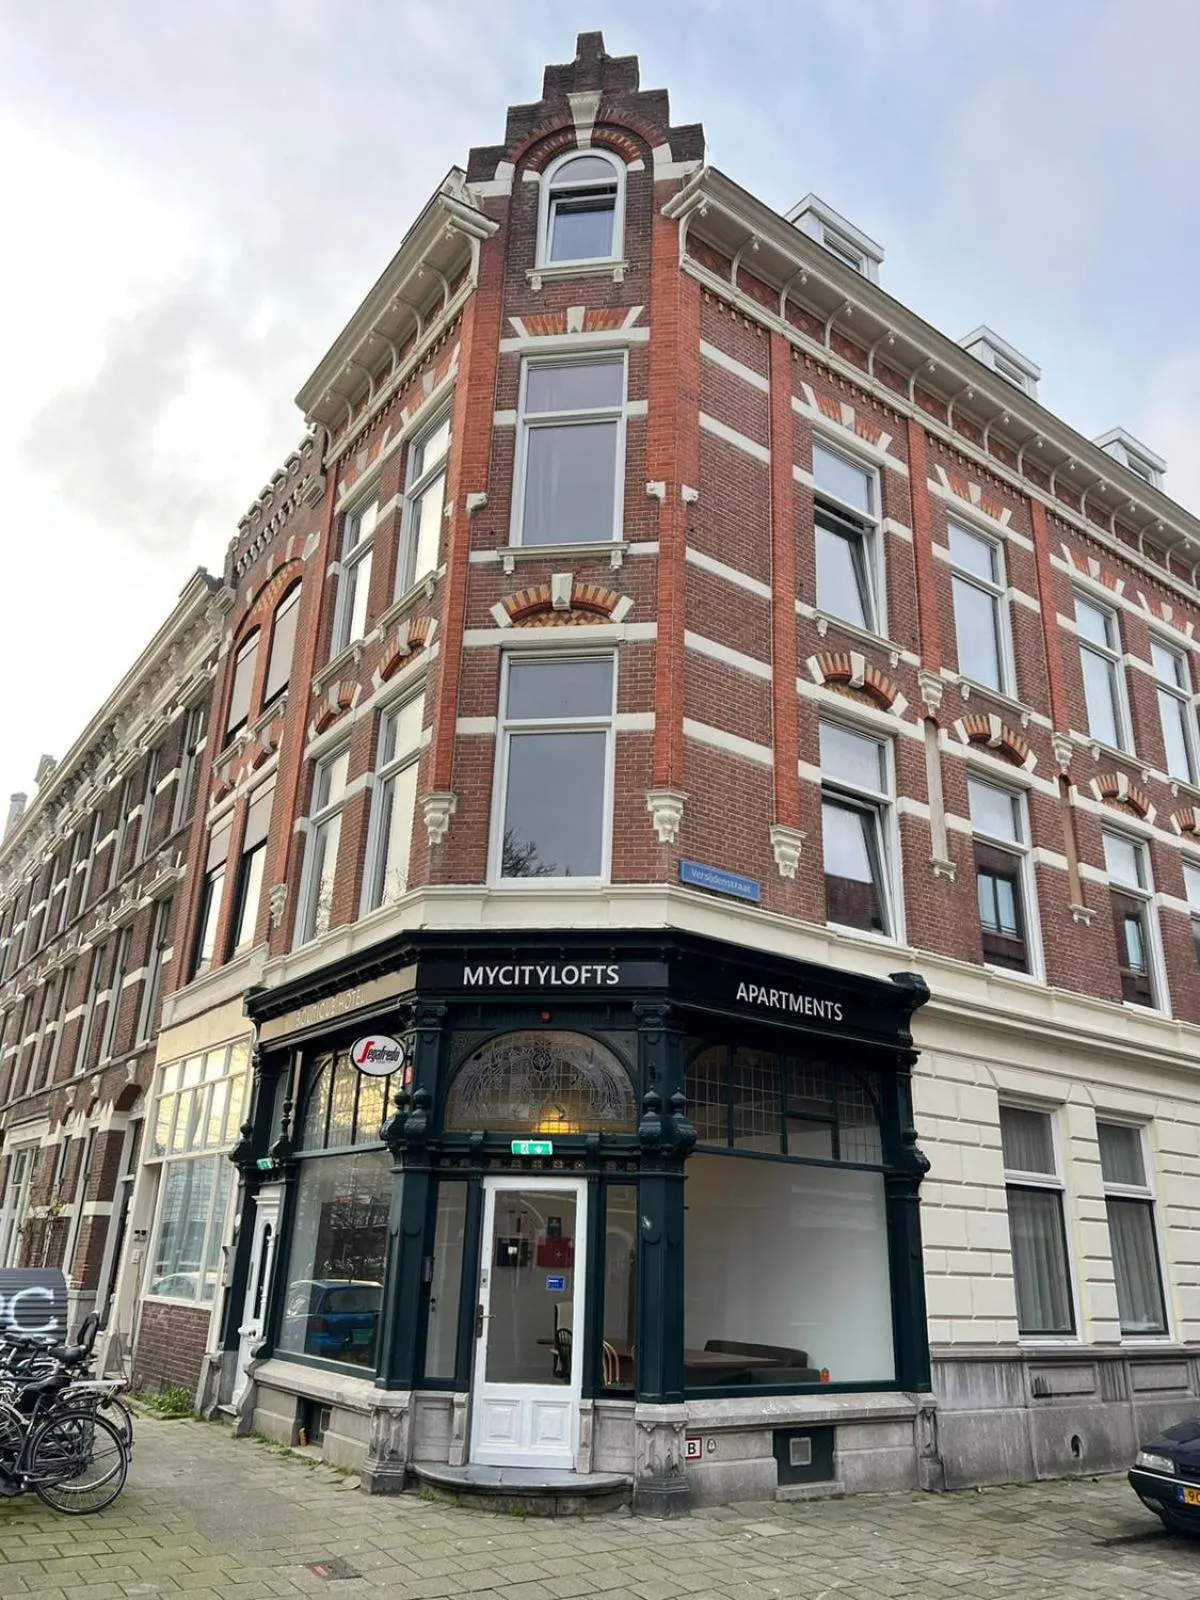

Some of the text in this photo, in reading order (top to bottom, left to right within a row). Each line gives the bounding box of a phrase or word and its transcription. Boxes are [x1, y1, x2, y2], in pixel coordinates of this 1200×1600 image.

[463, 965, 620, 985] MYCITYLOFTS
[736, 981, 843, 1021] APARTMENTS
[687, 1442, 697, 1455] B
